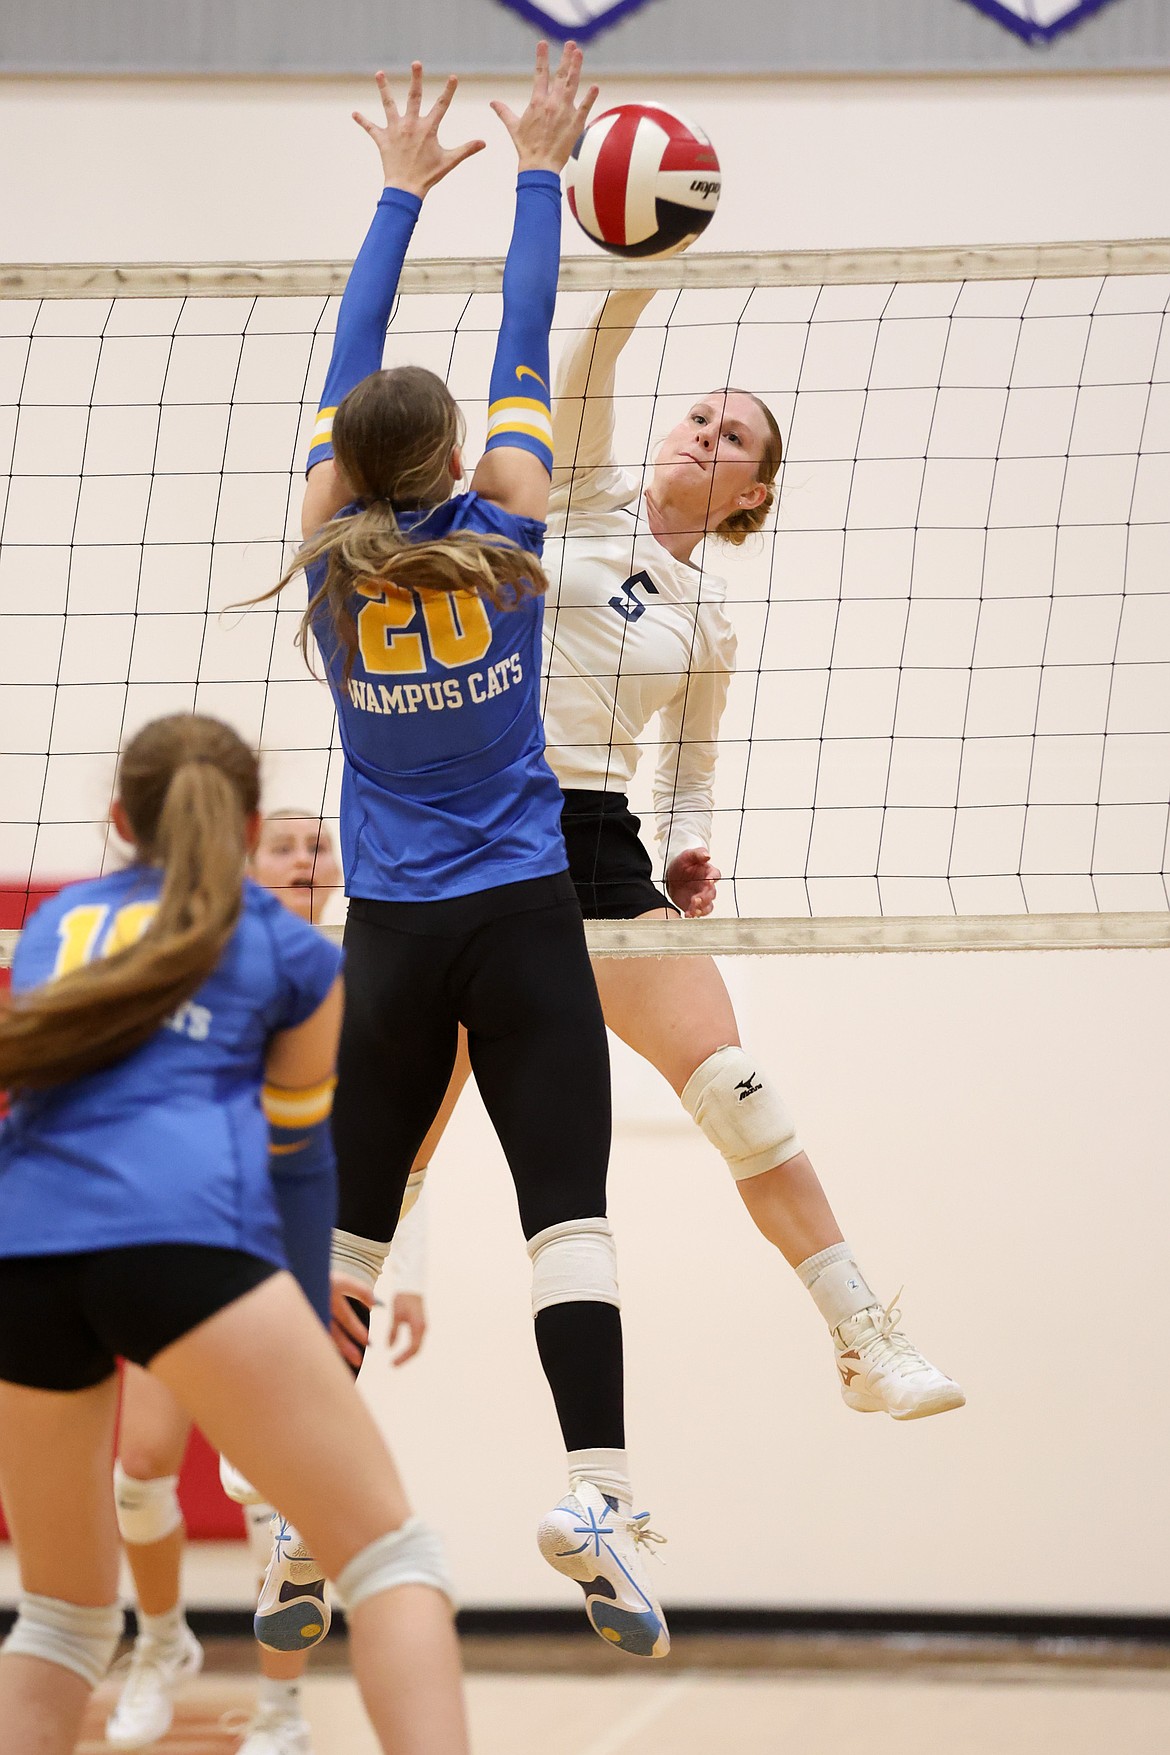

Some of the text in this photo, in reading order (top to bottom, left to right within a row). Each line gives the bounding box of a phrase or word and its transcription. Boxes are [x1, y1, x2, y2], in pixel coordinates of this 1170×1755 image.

[689, 180, 721, 201] aden
[607, 569, 660, 623] 5
[355, 579, 493, 675] 20
[347, 652, 524, 715] WAMPUS CATS
